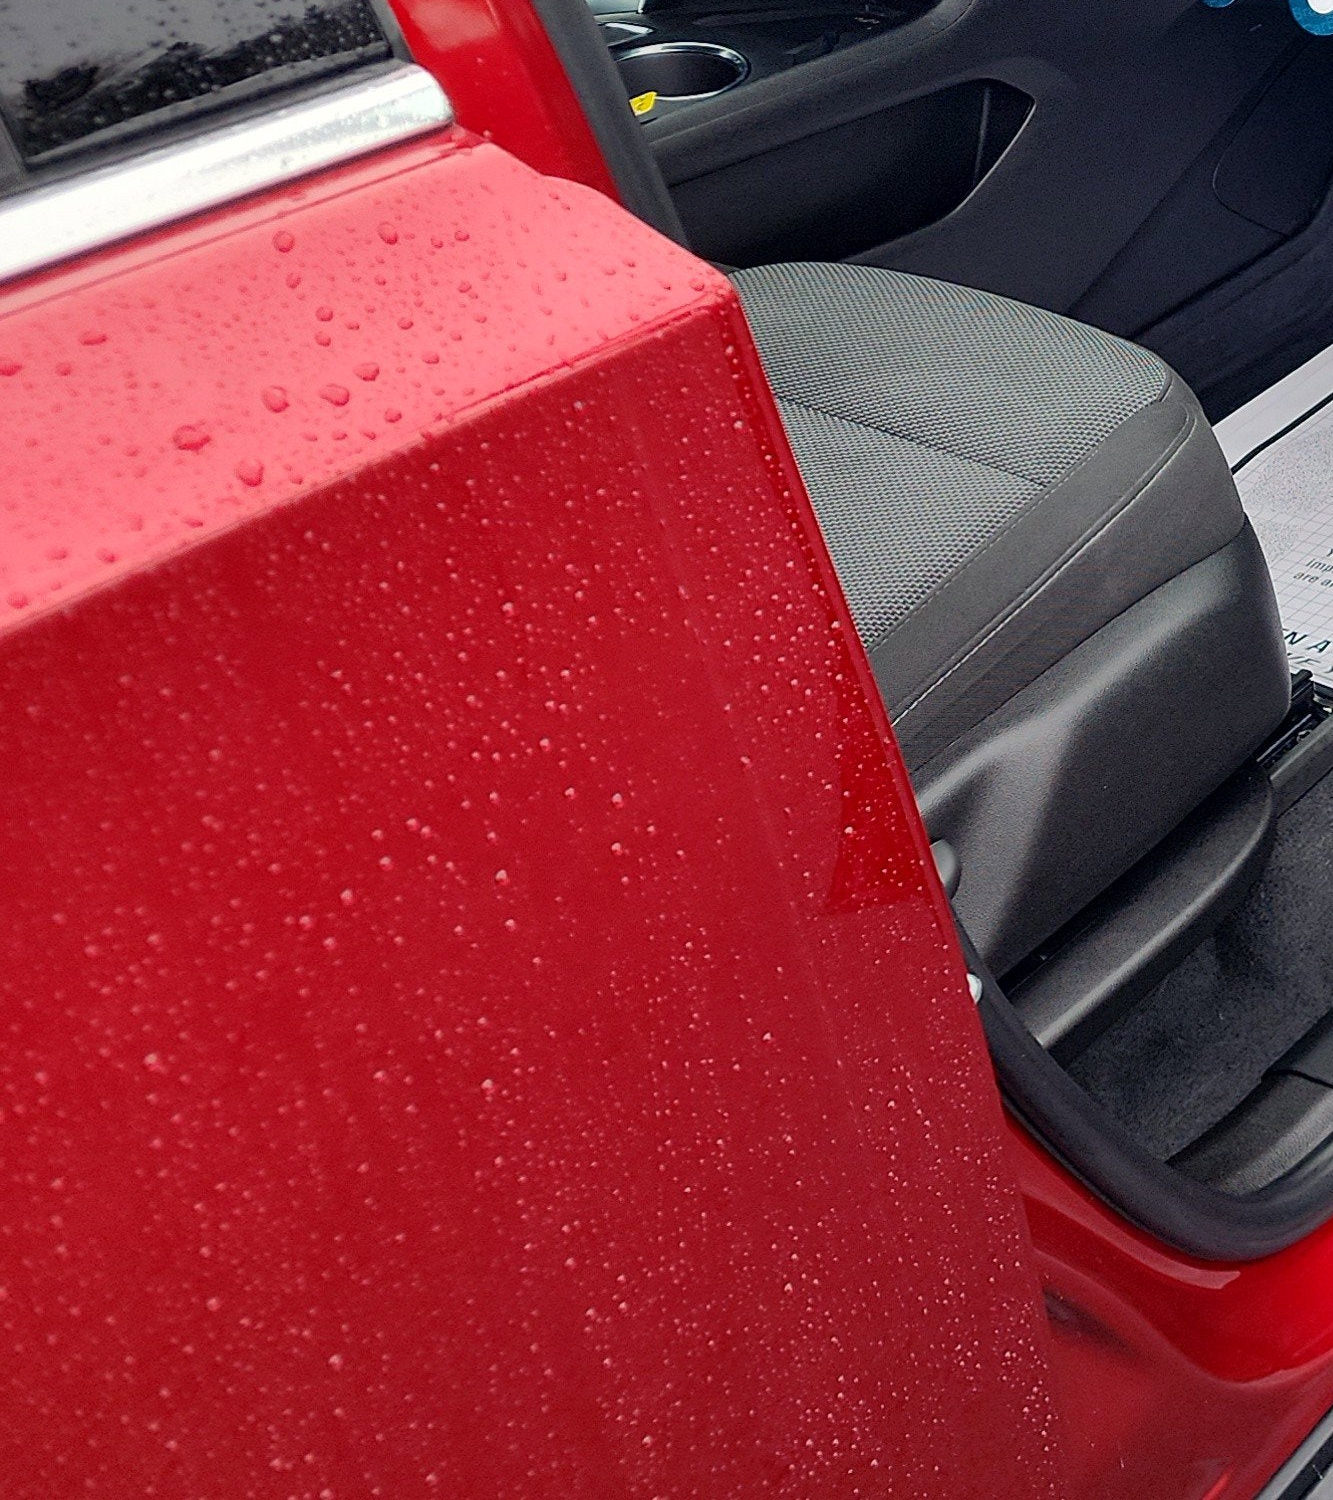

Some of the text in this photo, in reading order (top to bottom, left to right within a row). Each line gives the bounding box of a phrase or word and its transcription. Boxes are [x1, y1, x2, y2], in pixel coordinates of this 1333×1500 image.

[1293, 572, 1320, 584] are
[1282, 628, 1307, 646] N
[1307, 639, 1332, 653] A
